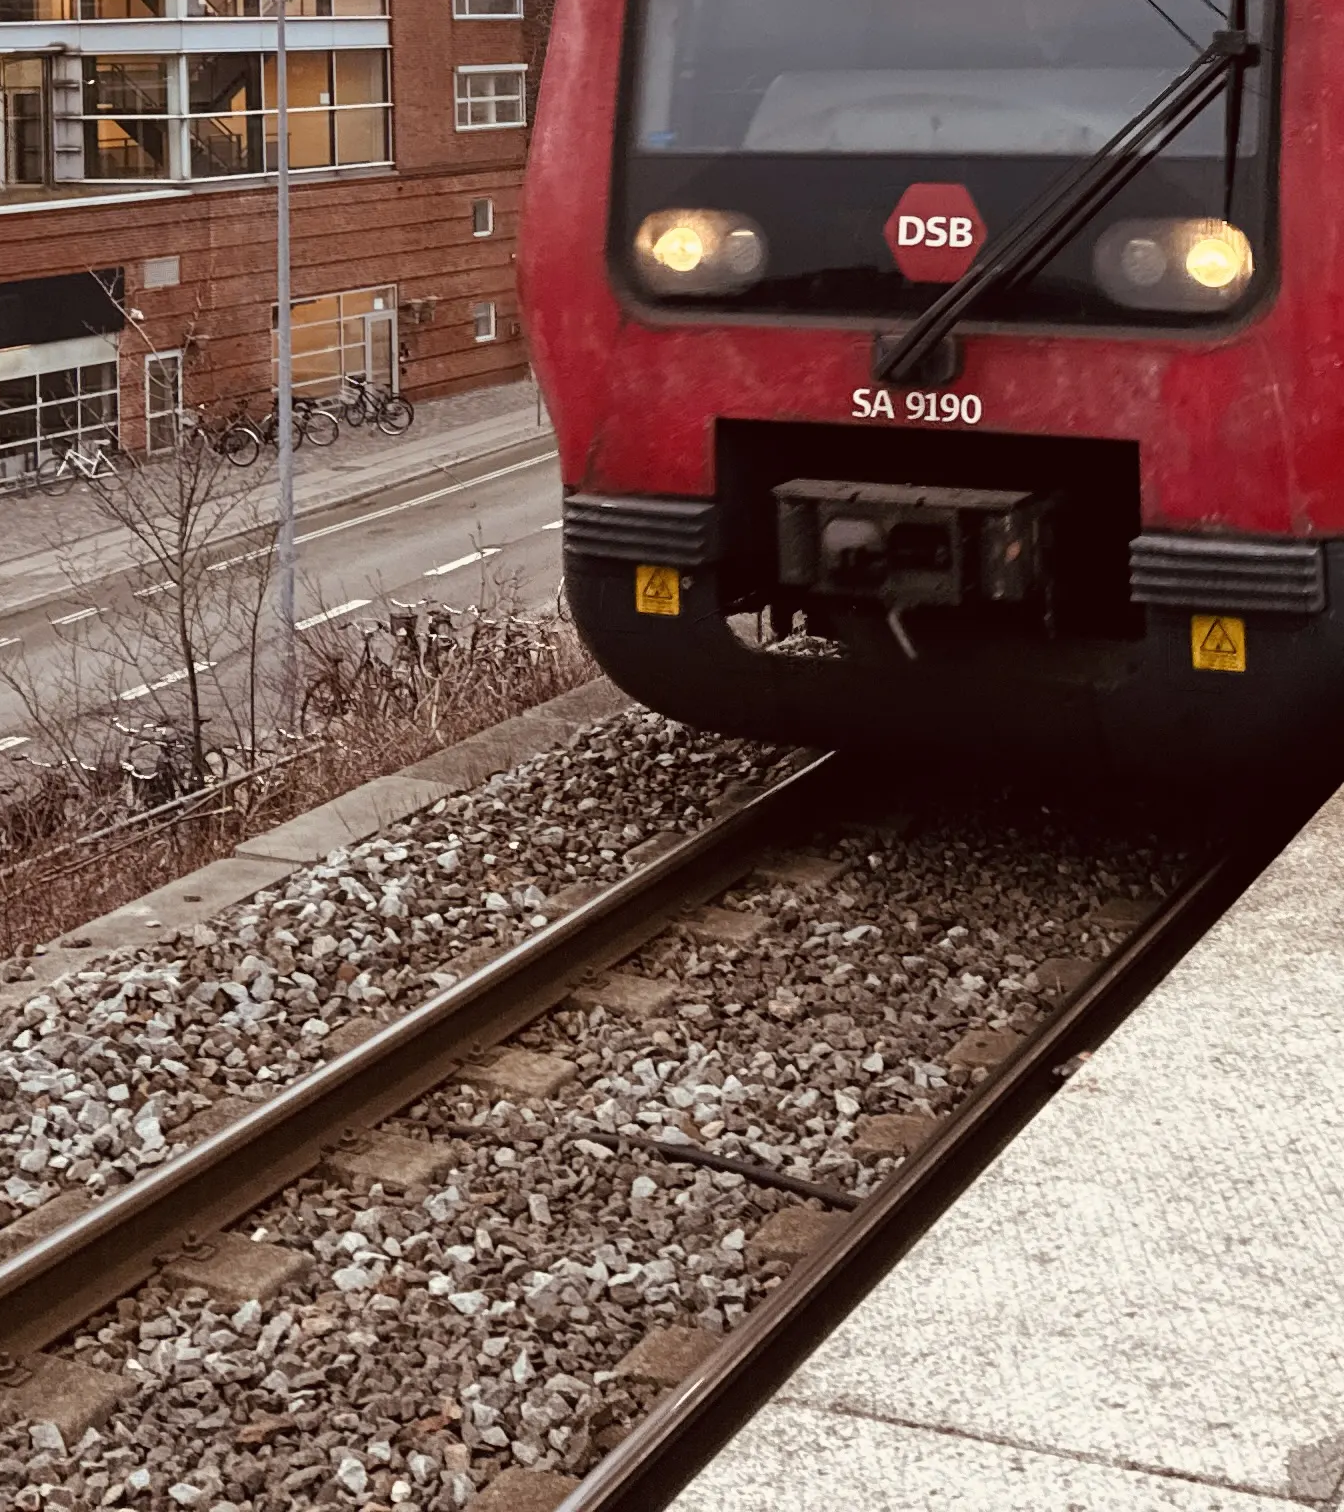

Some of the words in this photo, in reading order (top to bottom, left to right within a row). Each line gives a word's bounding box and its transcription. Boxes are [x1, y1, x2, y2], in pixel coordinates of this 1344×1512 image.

[897, 215, 973, 248] DSB
[852, 388, 895, 419] SA
[905, 391, 982, 424] 9190
